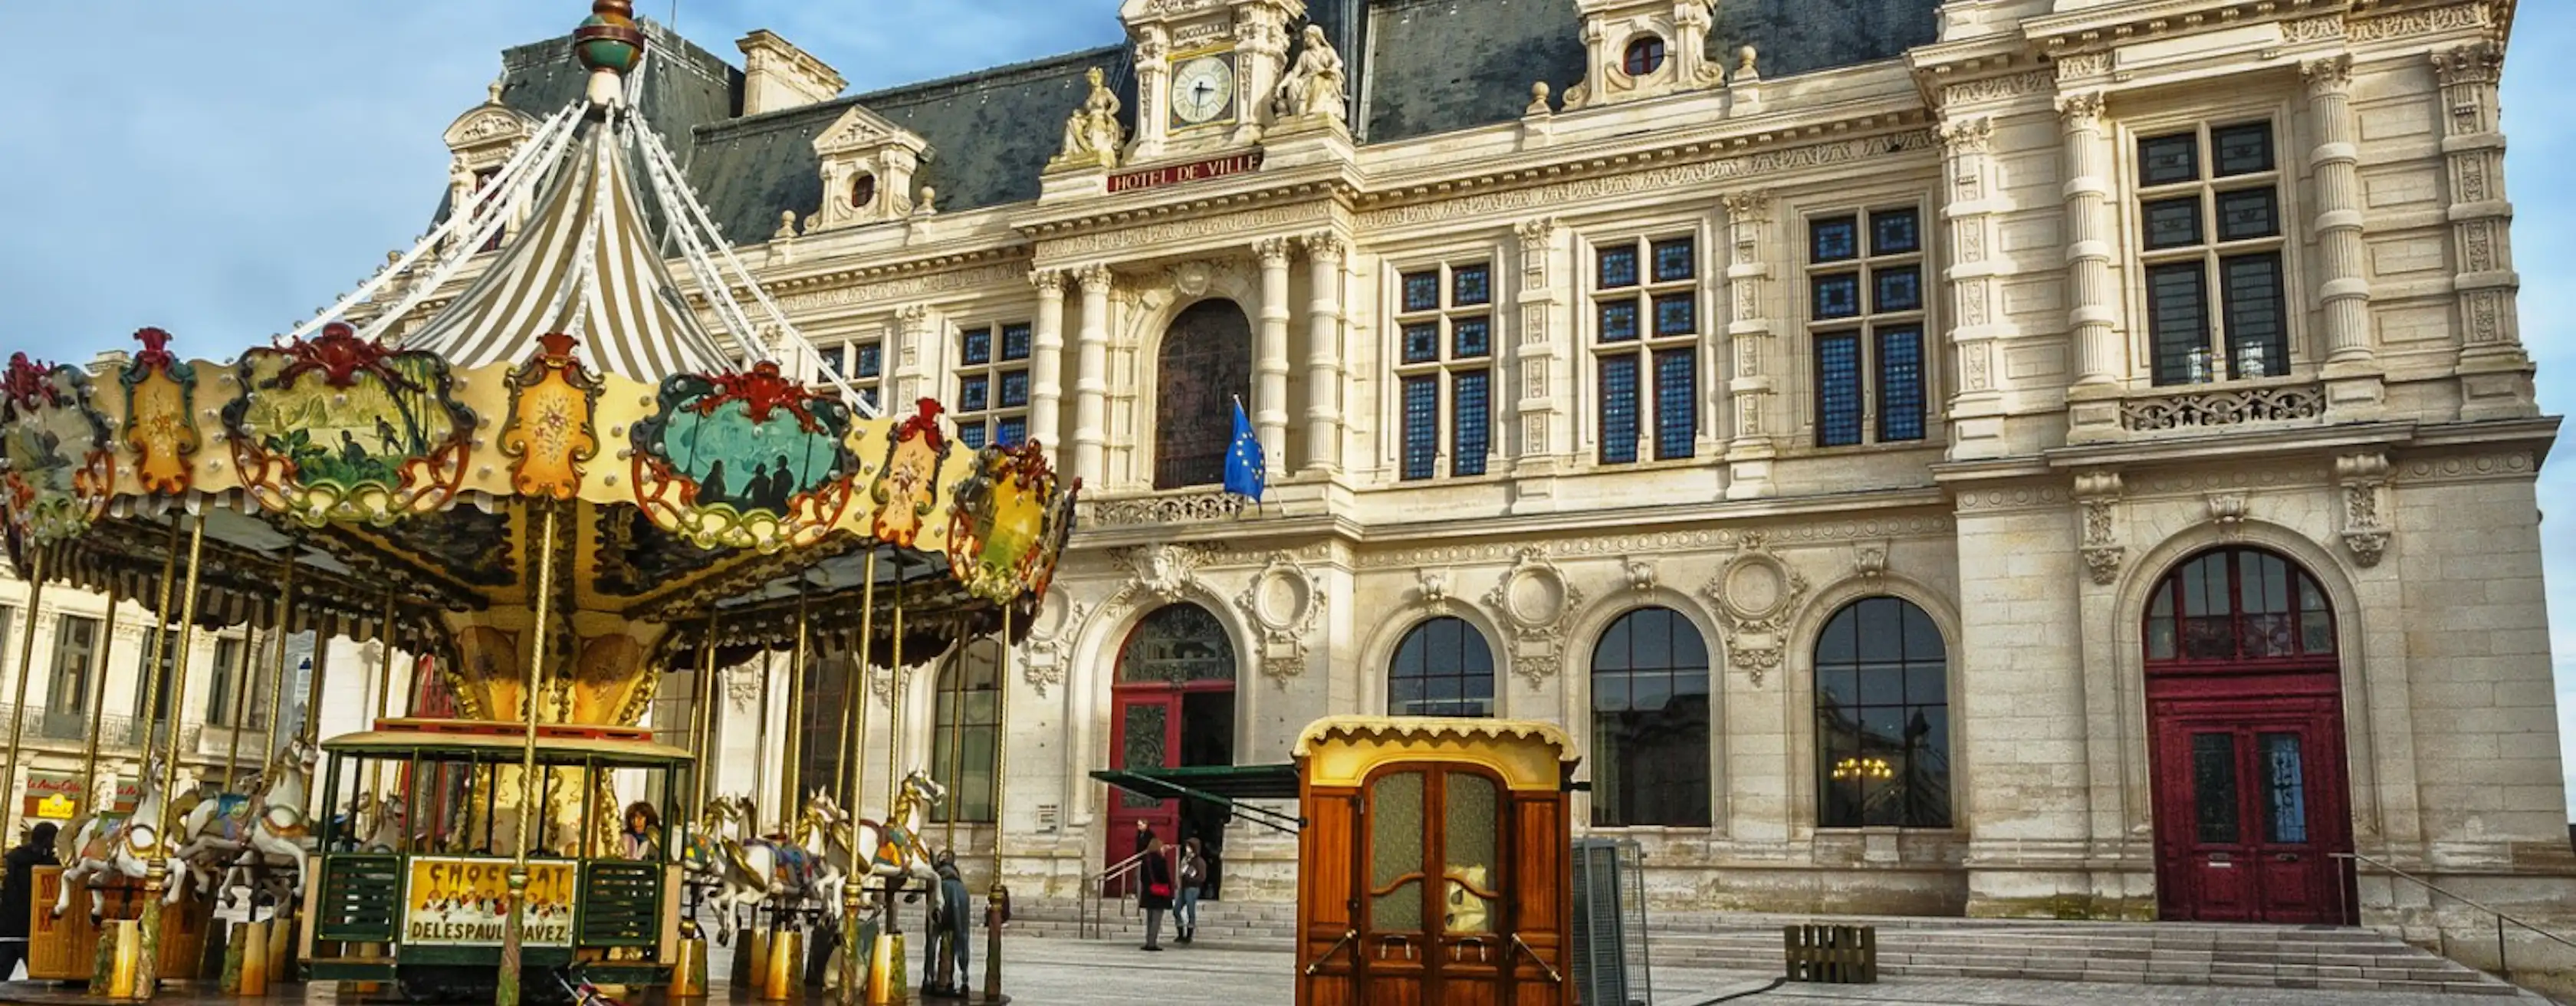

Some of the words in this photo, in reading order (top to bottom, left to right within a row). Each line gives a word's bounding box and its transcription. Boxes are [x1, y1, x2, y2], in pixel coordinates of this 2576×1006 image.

[1177, 163, 1200, 181] DE
[1207, 155, 1258, 176] VILLE
[430, 863, 567, 884] CHOCAT
[412, 922, 504, 940] DELESPAUL
[521, 924, 566, 941] AVEZ
